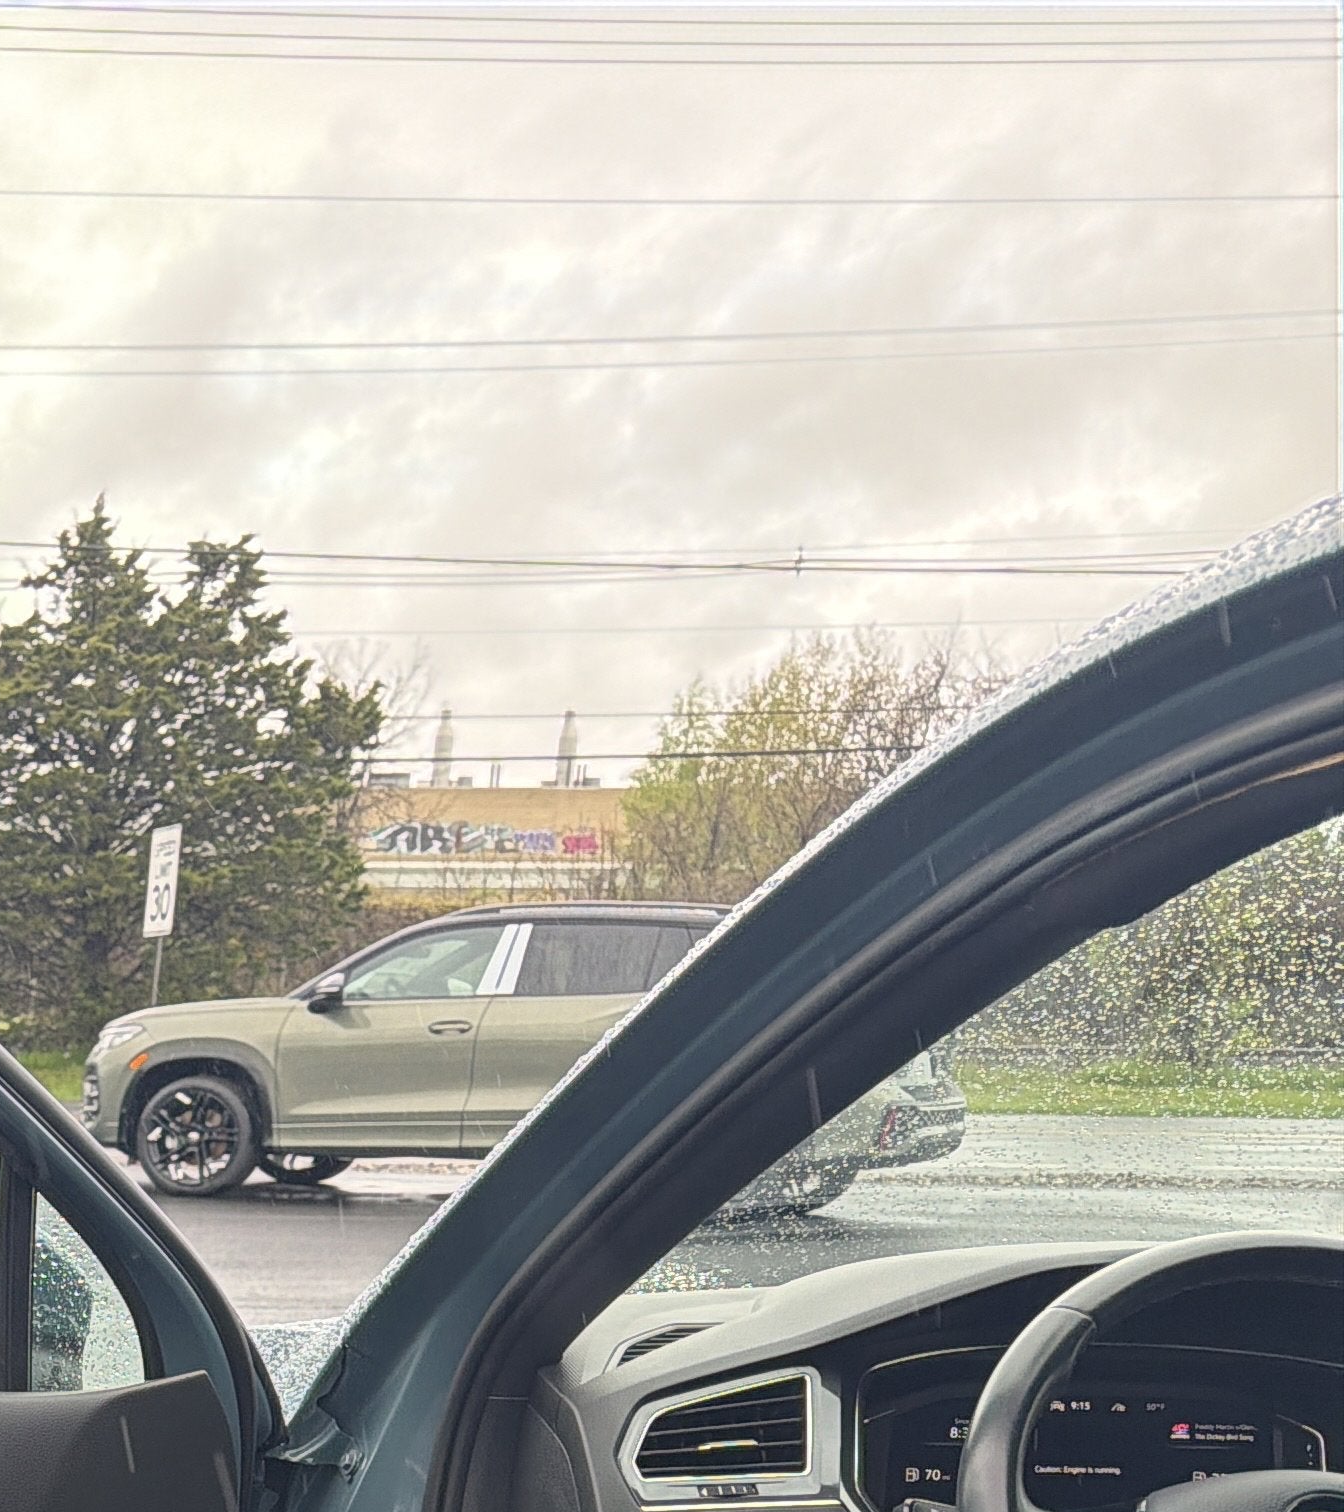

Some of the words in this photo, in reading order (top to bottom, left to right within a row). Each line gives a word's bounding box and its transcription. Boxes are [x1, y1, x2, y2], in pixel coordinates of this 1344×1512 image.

[150, 883, 171, 922] 30
[1070, 1401, 1091, 1411] 9:15
[924, 1468, 941, 1481] 70
